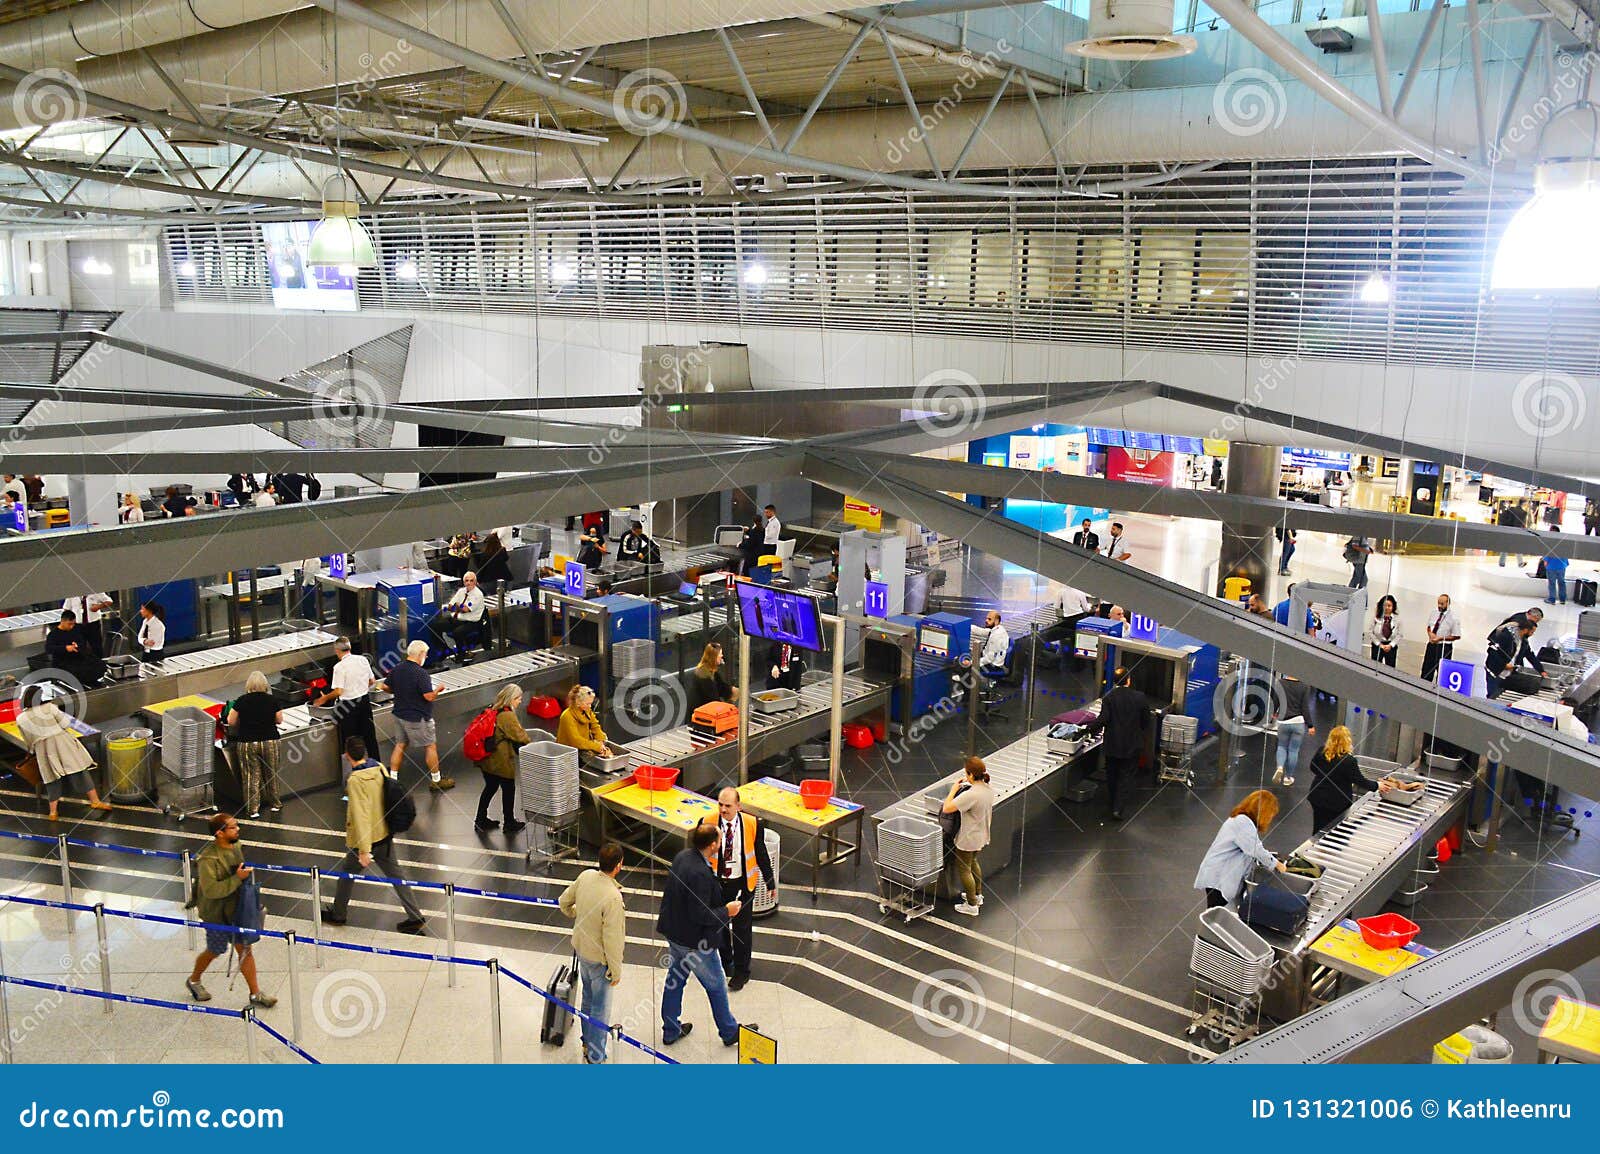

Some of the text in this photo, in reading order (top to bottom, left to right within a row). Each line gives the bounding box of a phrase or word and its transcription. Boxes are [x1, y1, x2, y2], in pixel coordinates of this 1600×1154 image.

[16, 509, 24, 524] 15
[331, 554, 342, 571] 13
[567, 570, 581, 589] 12
[869, 590, 884, 610] 11
[1135, 614, 1154, 632] 10
[1448, 672, 1462, 692] 9
